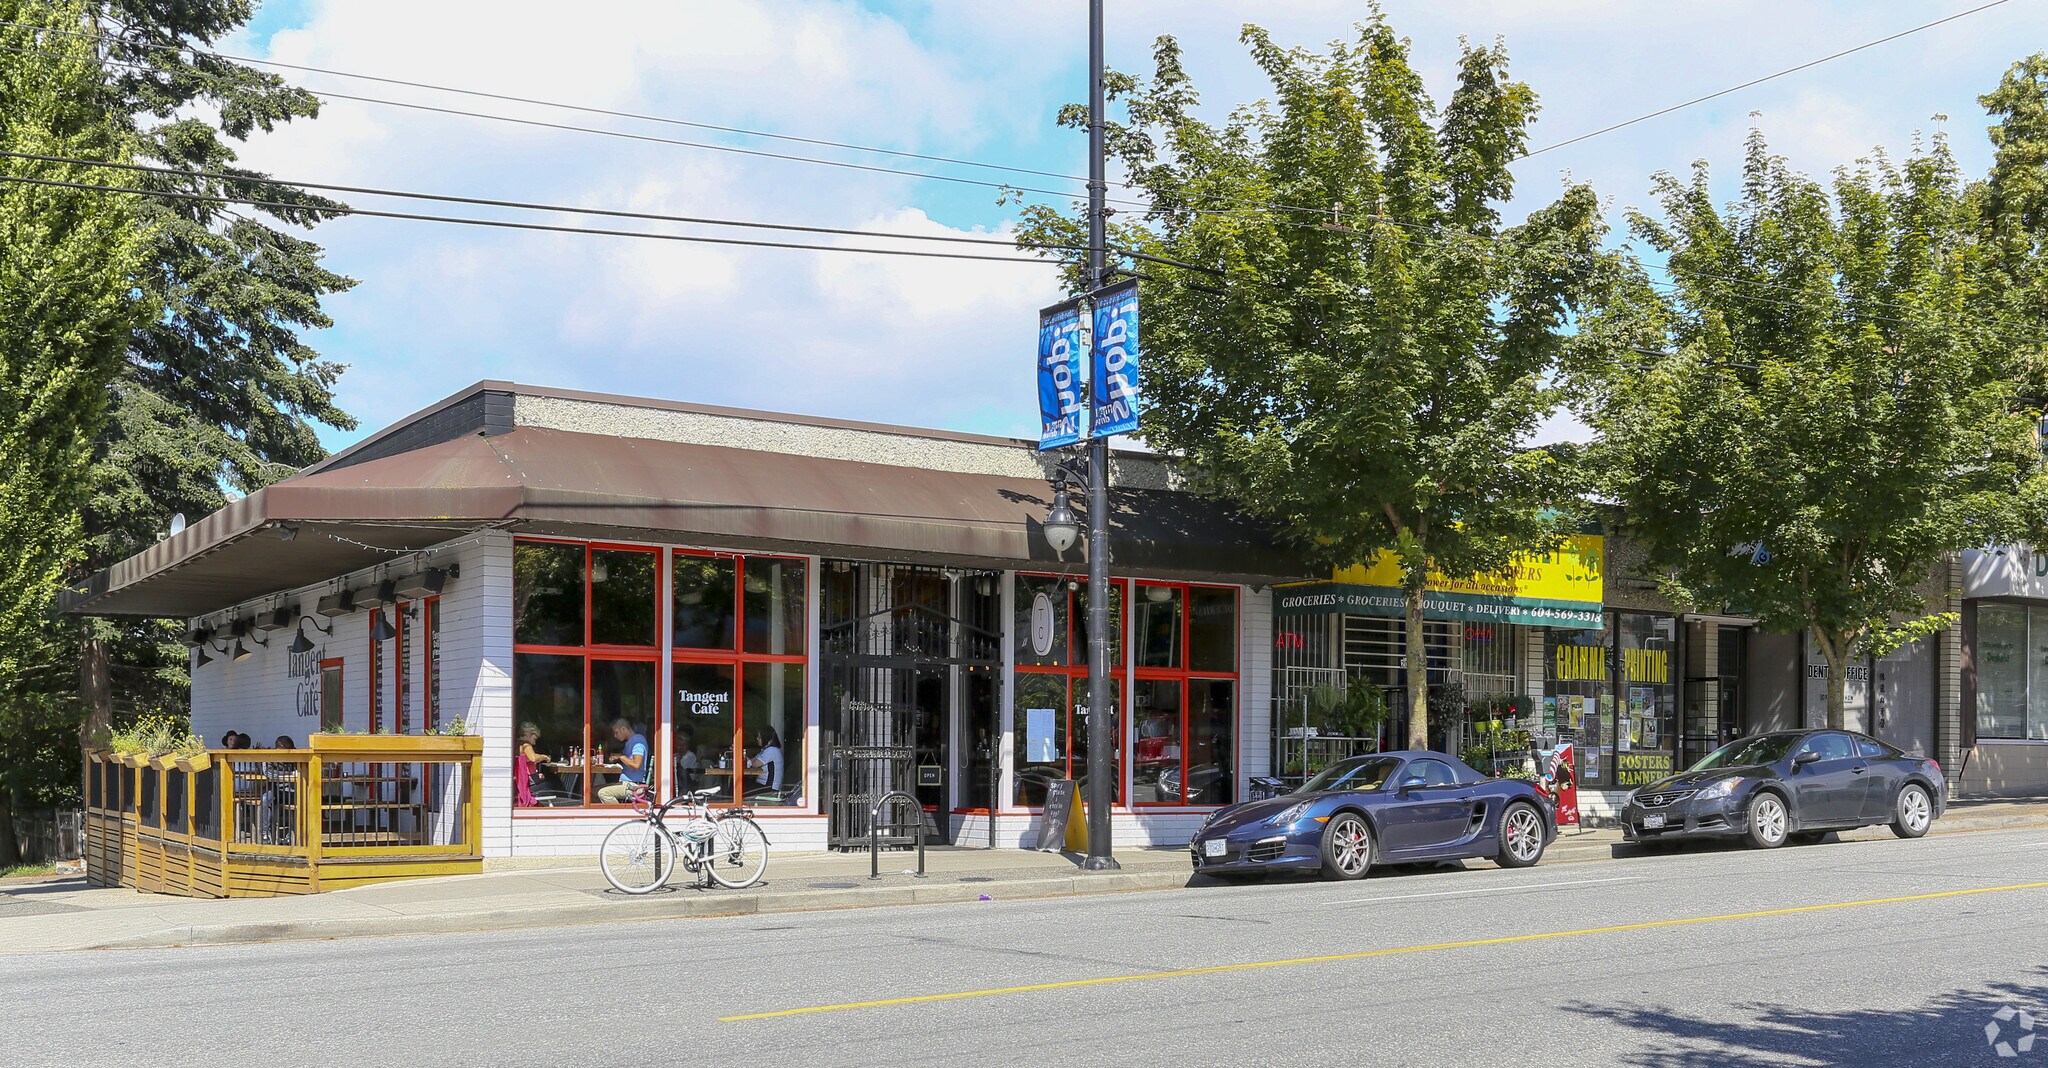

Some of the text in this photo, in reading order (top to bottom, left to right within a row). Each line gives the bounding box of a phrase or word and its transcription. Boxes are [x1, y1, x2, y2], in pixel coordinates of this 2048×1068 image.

[1282, 594, 1602, 623] GROCERIES GROCERIES OUQUET DELIVERY 604-569-3318
[1275, 632, 1305, 649] ATM
[1557, 644, 1667, 683] GRAMMA PRINTING
[1808, 664, 1868, 681] DENT FFICE
[297, 679, 320, 717] Café
[679, 690, 728, 705] Tangent
[691, 702, 720, 715] Café
[1618, 755, 1670, 769] POSTERS
